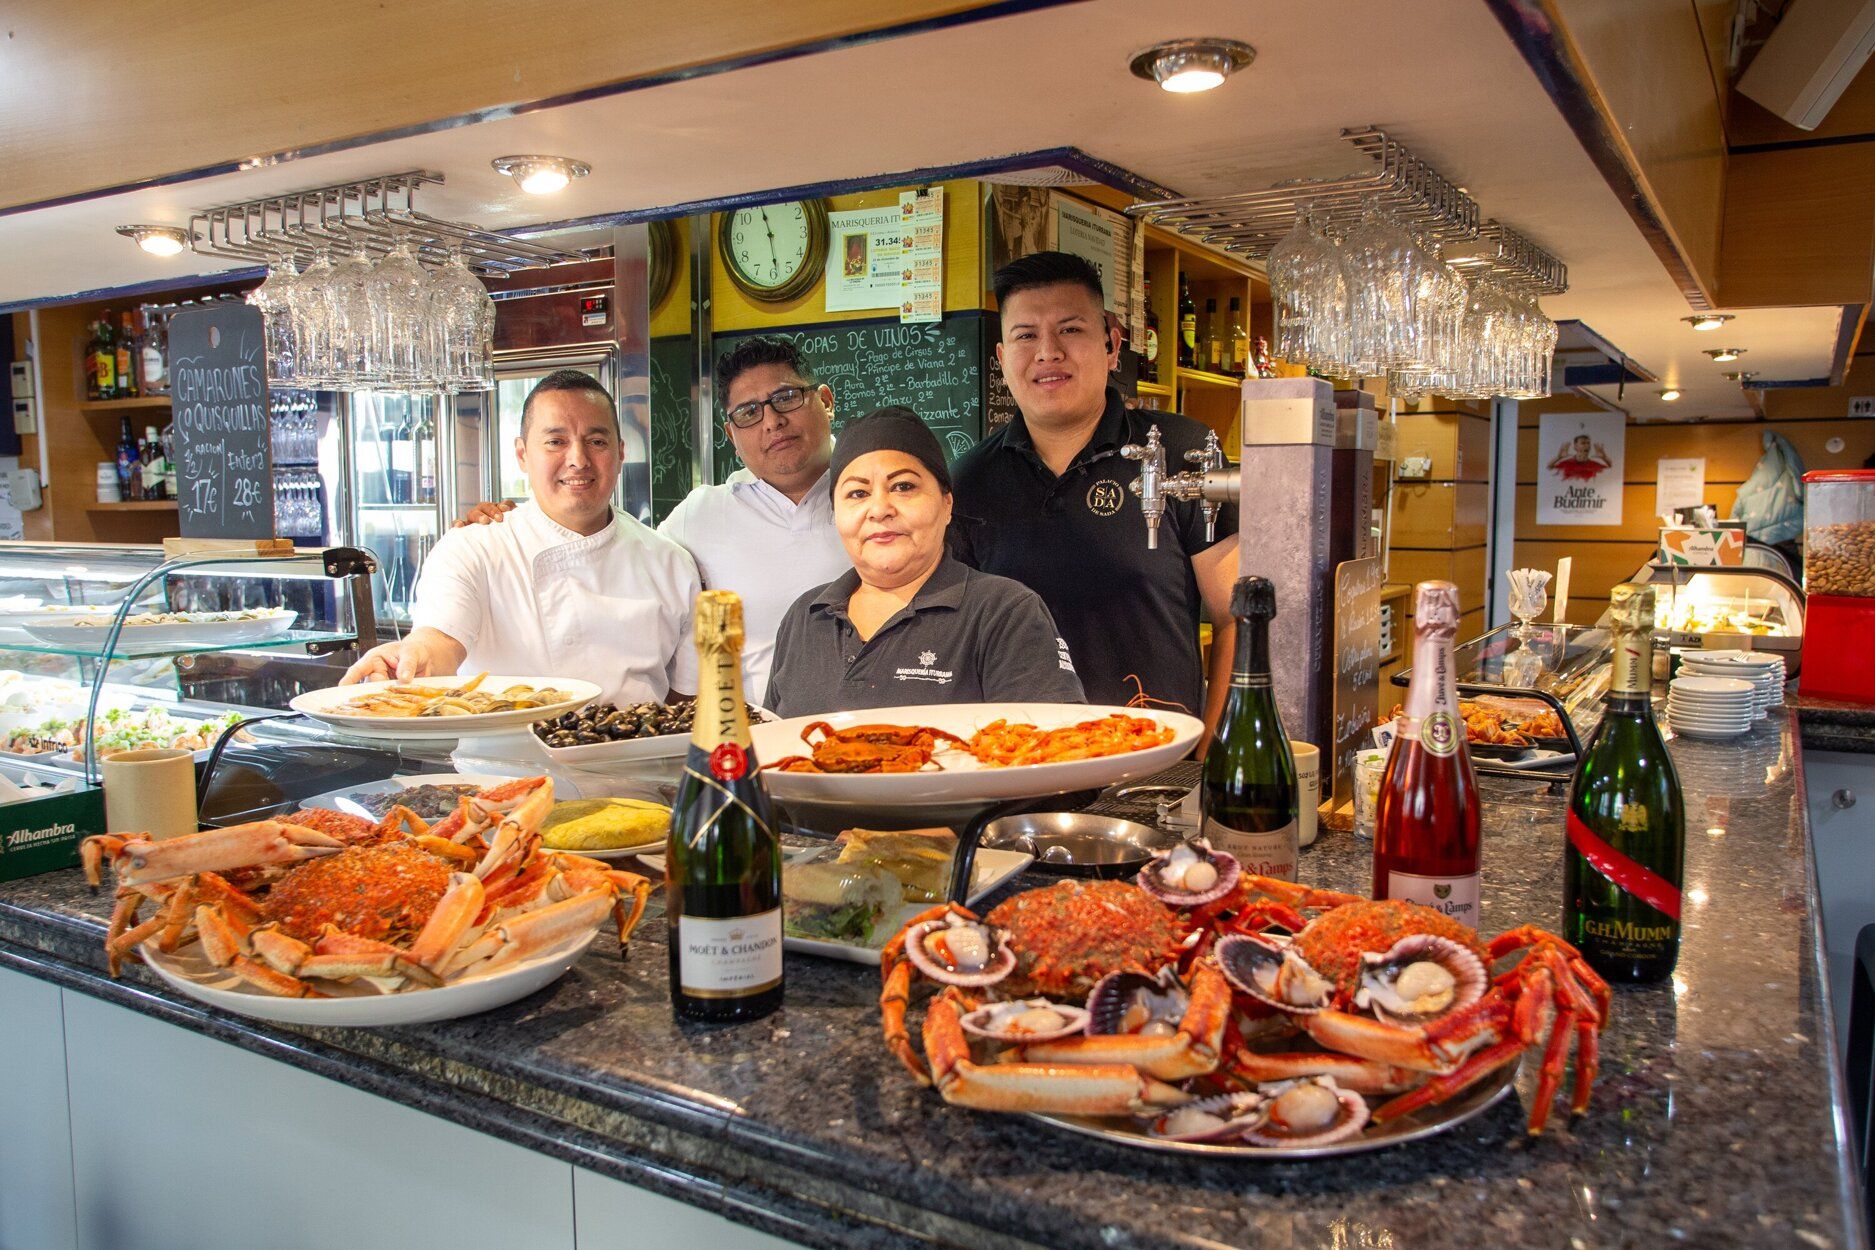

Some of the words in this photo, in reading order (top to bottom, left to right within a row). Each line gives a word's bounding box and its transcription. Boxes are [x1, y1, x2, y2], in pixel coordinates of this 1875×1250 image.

[740, 212, 752, 225] 10
[794, 207, 802, 220] 2
[832, 216, 888, 228] MARISQUERIA
[736, 232, 744, 244] 9
[800, 226, 808, 239] 3
[741, 251, 749, 263] 8
[796, 246, 803, 258] 4
[754, 264, 760, 276] 7
[769, 267, 778, 280] 6
[785, 261, 793, 274] 5
[793, 332, 838, 354] COPAS
[847, 331, 867, 350] DE
[874, 325, 921, 348] VINOS
[866, 351, 888, 364] Pago
[892, 348, 903, 359] de
[904, 361, 915, 370] de
[918, 359, 944, 370] Viana
[178, 366, 262, 402] CAMARONES
[906, 371, 959, 389] Barbadillo
[194, 403, 266, 433] QUISQUILLAS
[228, 449, 264, 471] Entera
[192, 479, 217, 514] 17€
[233, 478, 262, 507] 28€
[1564, 485, 1595, 498] Ante
[1553, 495, 1607, 509] Budimir
[41, 736, 68, 753] infrico
[6, 823, 75, 847] Alhambra
[1260, 861, 1293, 875] Camps
[1445, 901, 1473, 915] Camps
[721, 946, 728, 955] &
[732, 937, 777, 954] CHANDON
